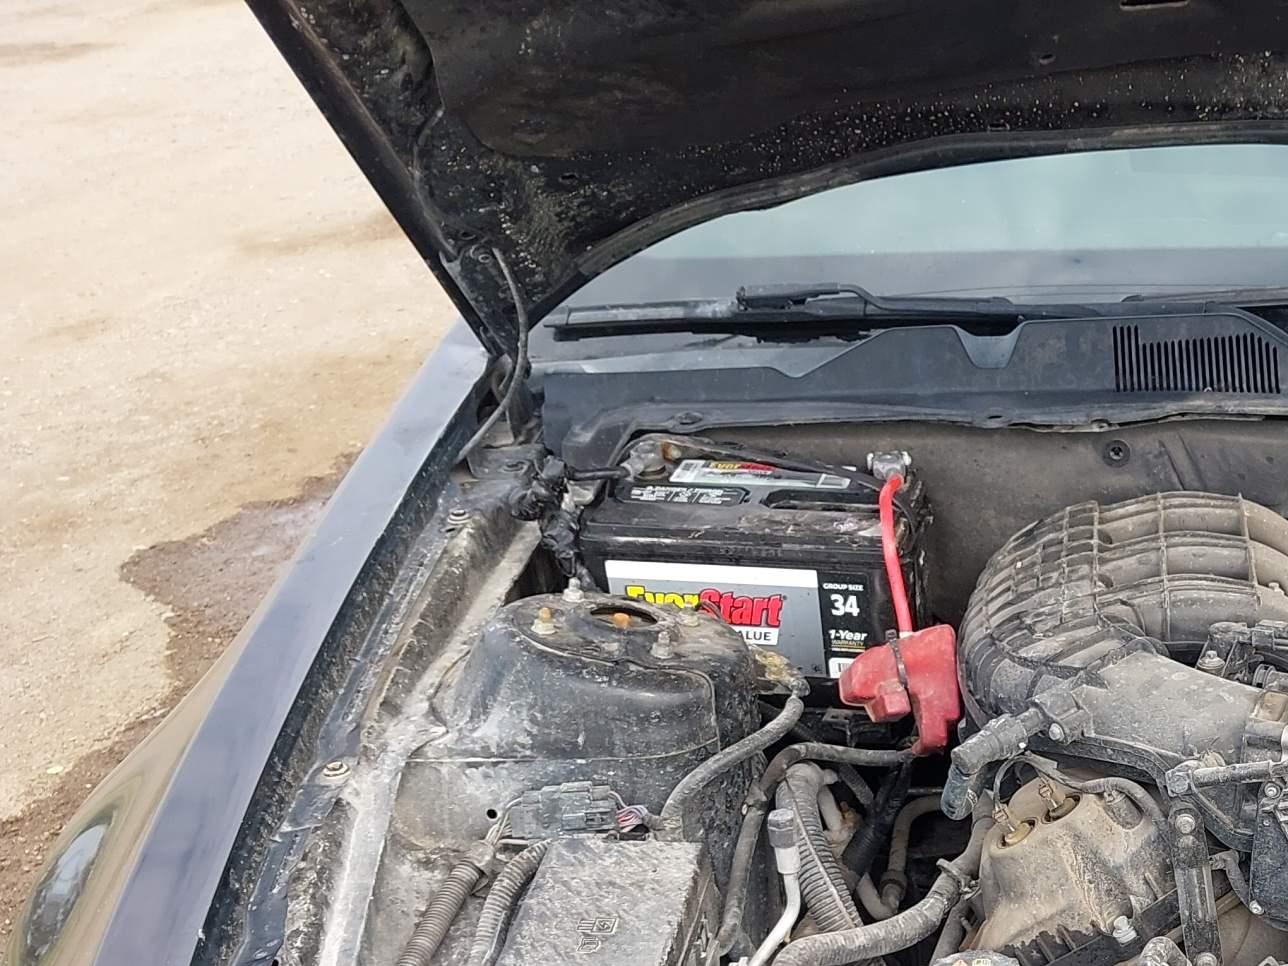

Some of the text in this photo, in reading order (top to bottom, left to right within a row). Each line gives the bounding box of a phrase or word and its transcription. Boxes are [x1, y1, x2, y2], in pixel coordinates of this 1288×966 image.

[830, 593, 860, 617] 34
[737, 630, 772, 641] ALUE
[828, 629, 867, 641] 1-Year
